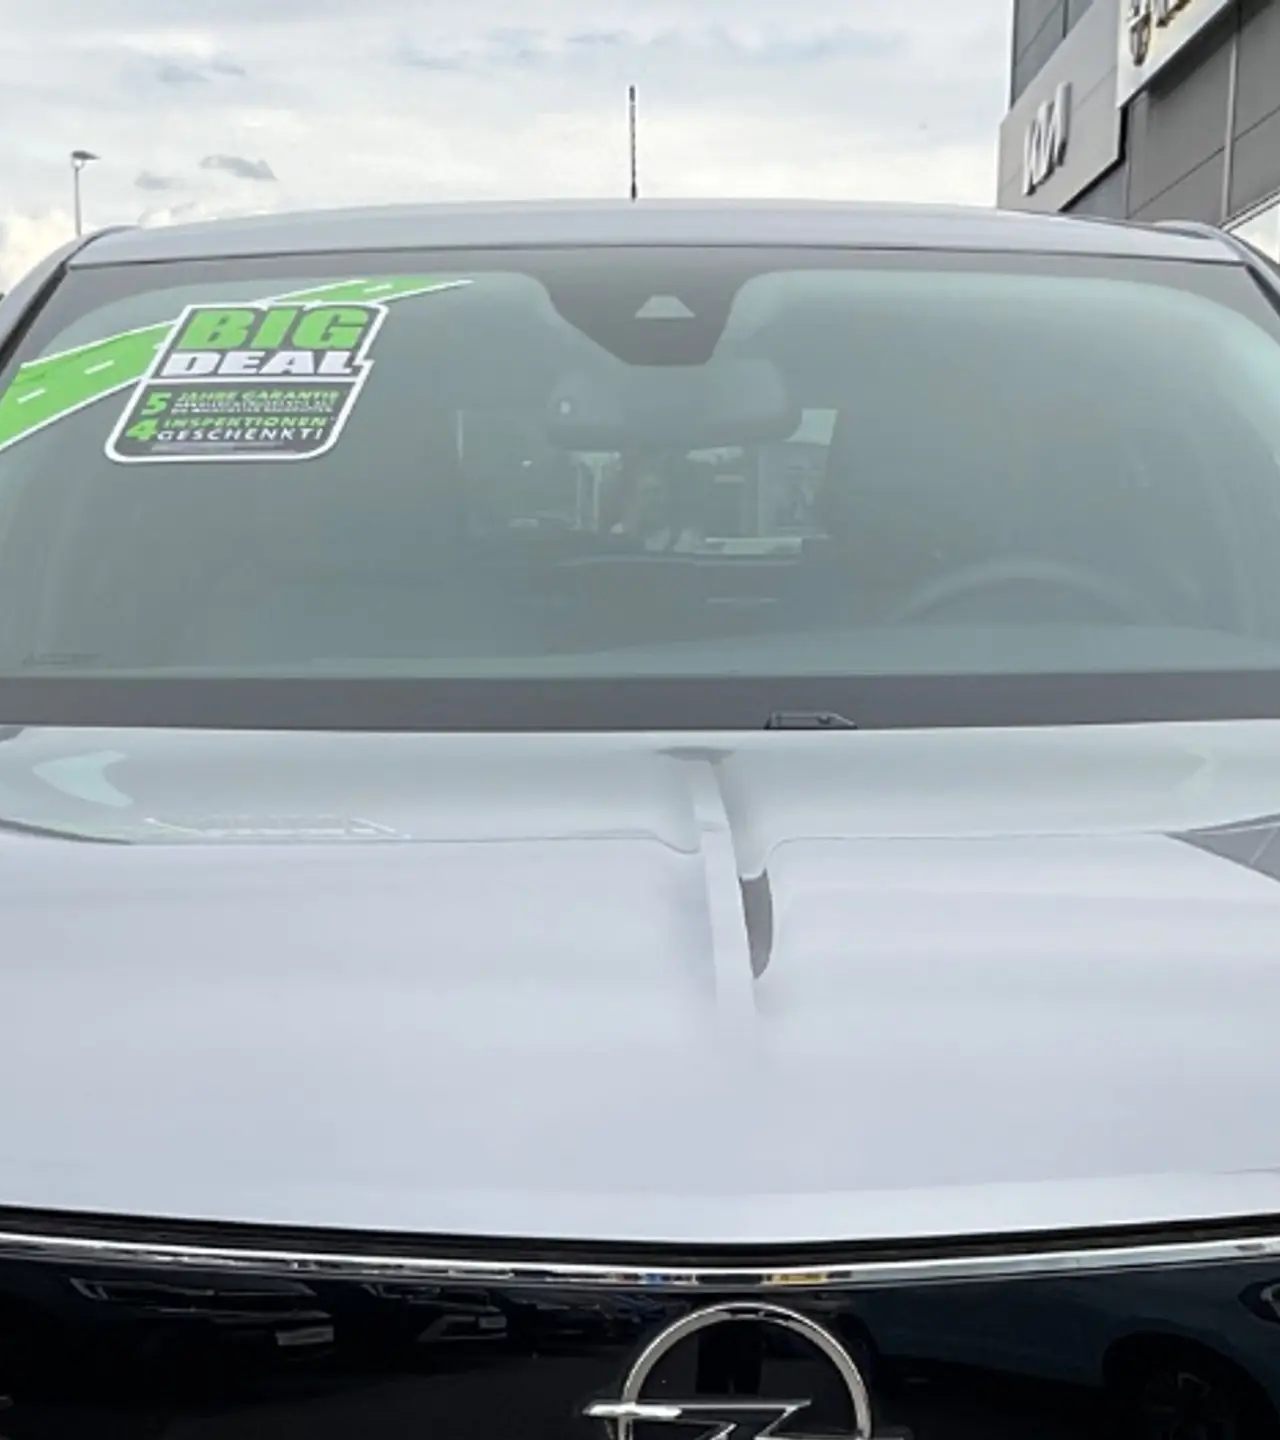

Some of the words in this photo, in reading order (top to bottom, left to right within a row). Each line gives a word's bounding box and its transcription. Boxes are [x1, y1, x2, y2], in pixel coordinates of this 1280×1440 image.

[178, 308, 369, 349] BIG
[161, 351, 353, 376] DEAL
[140, 393, 171, 415] 5
[125, 419, 159, 440] 4
